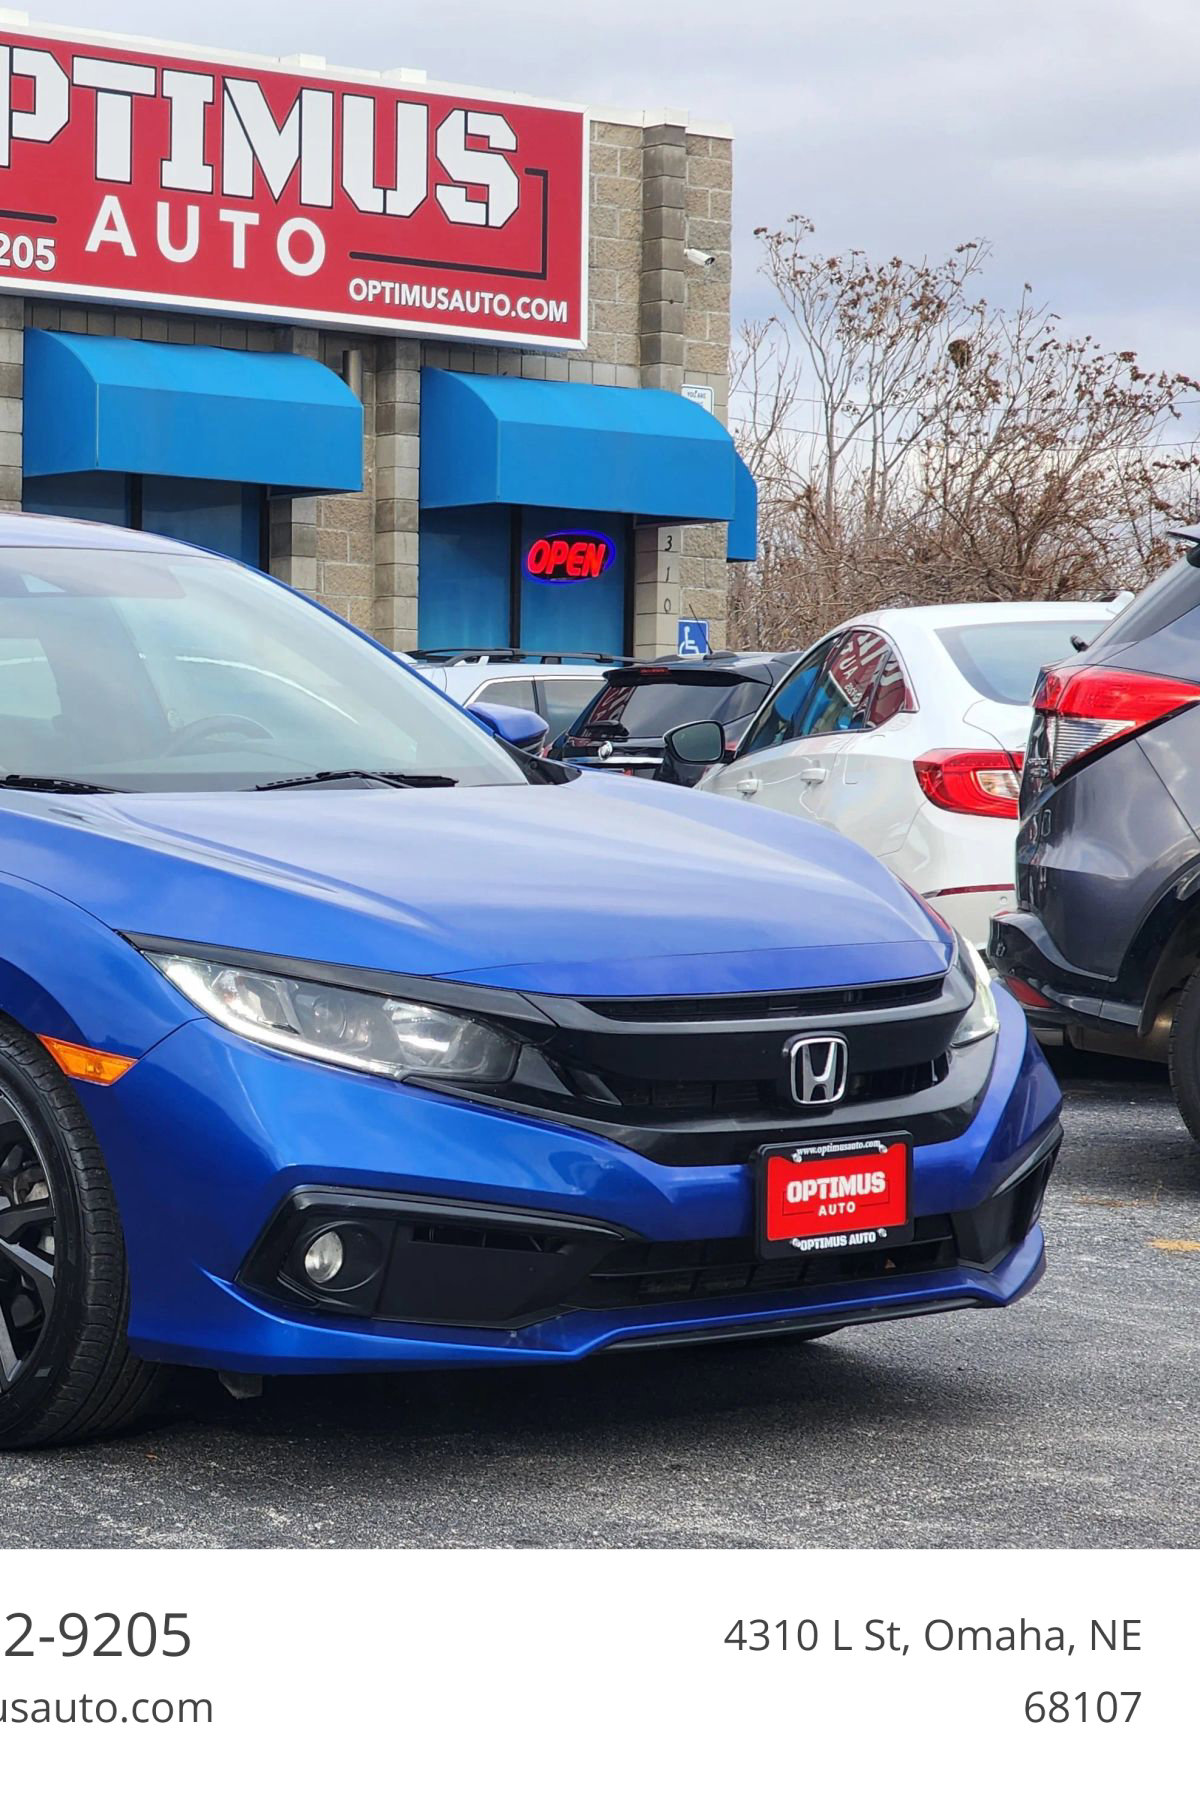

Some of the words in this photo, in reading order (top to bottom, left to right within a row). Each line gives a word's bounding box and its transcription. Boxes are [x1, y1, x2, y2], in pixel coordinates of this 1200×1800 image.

[85, 195, 327, 276] AUTO
[348, 277, 569, 324] OPTIMUSAUTO.COM
[527, 539, 606, 577] OPEN
[786, 1171, 886, 1203] OPTIMUS
[818, 1201, 856, 1217] AUTO
[800, 1235, 848, 1251] OPTIMUS
[849, 1231, 877, 1246] AUTO
